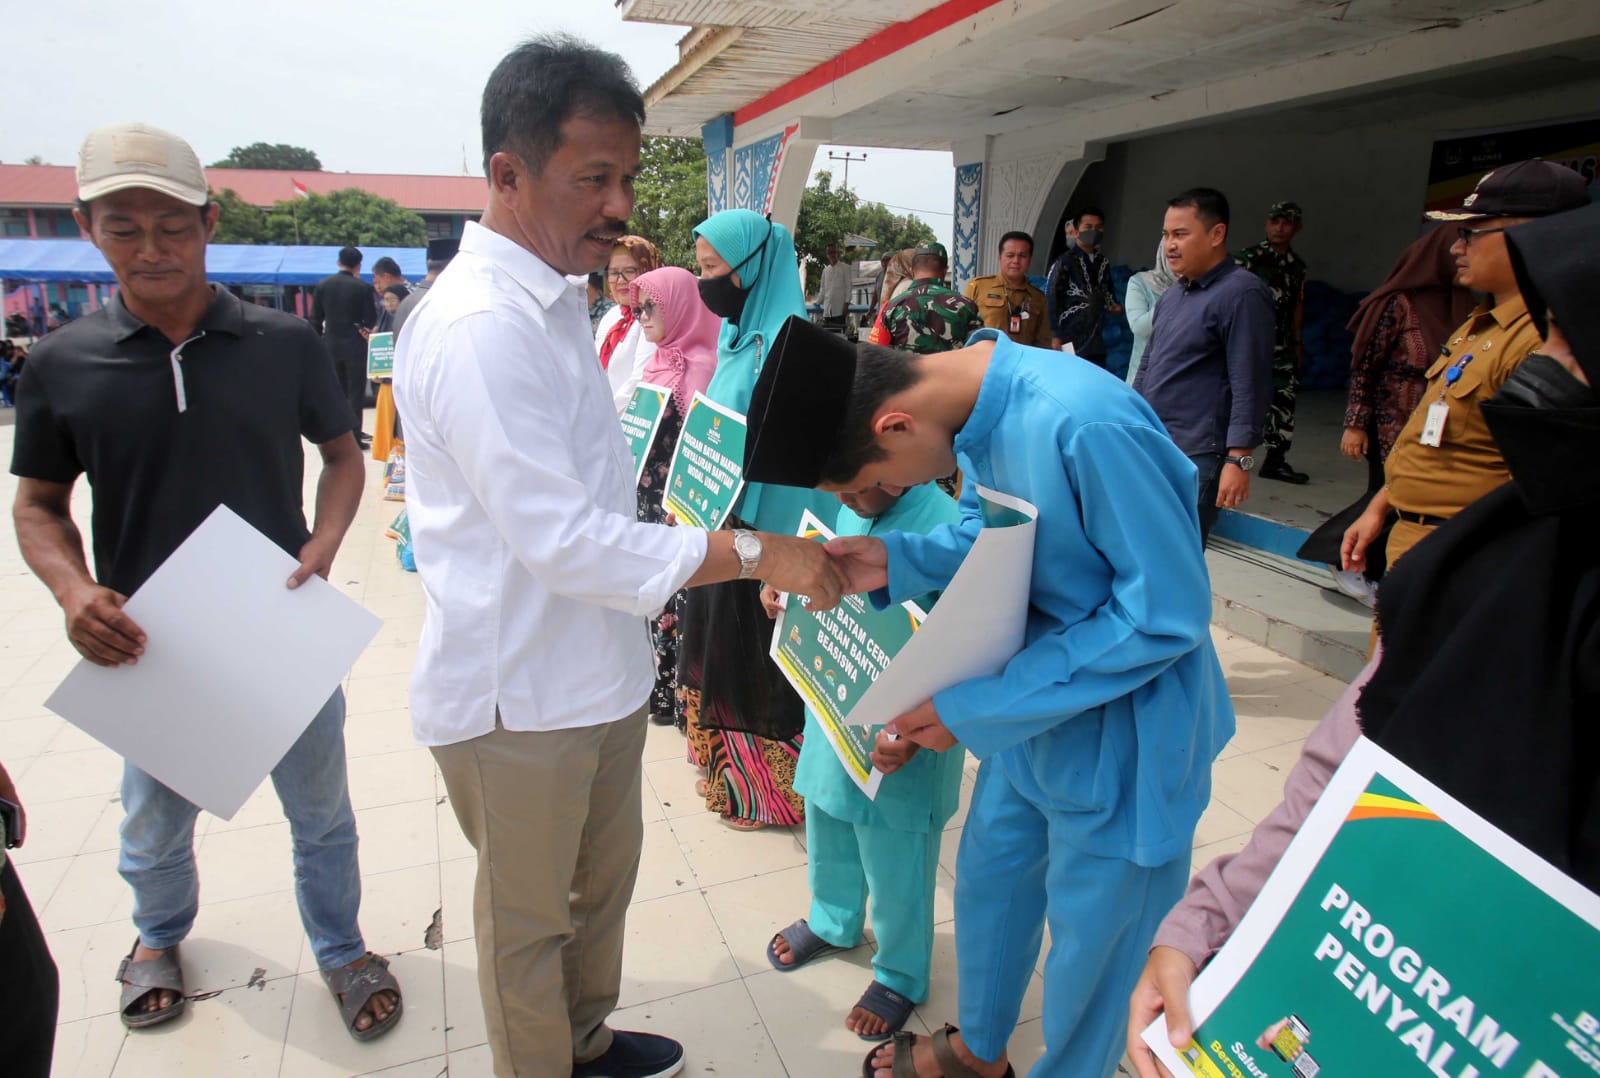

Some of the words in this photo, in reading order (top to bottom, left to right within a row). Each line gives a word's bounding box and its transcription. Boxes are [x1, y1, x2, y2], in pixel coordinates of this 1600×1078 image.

[683, 431, 704, 453] PROGRAM
[702, 444, 720, 464] BATAM
[711, 465, 734, 490] BANTUAN
[836, 606, 867, 645] BATAM
[817, 629, 858, 683] BEASISWA
[1320, 882, 1520, 1069] PROGRAM
